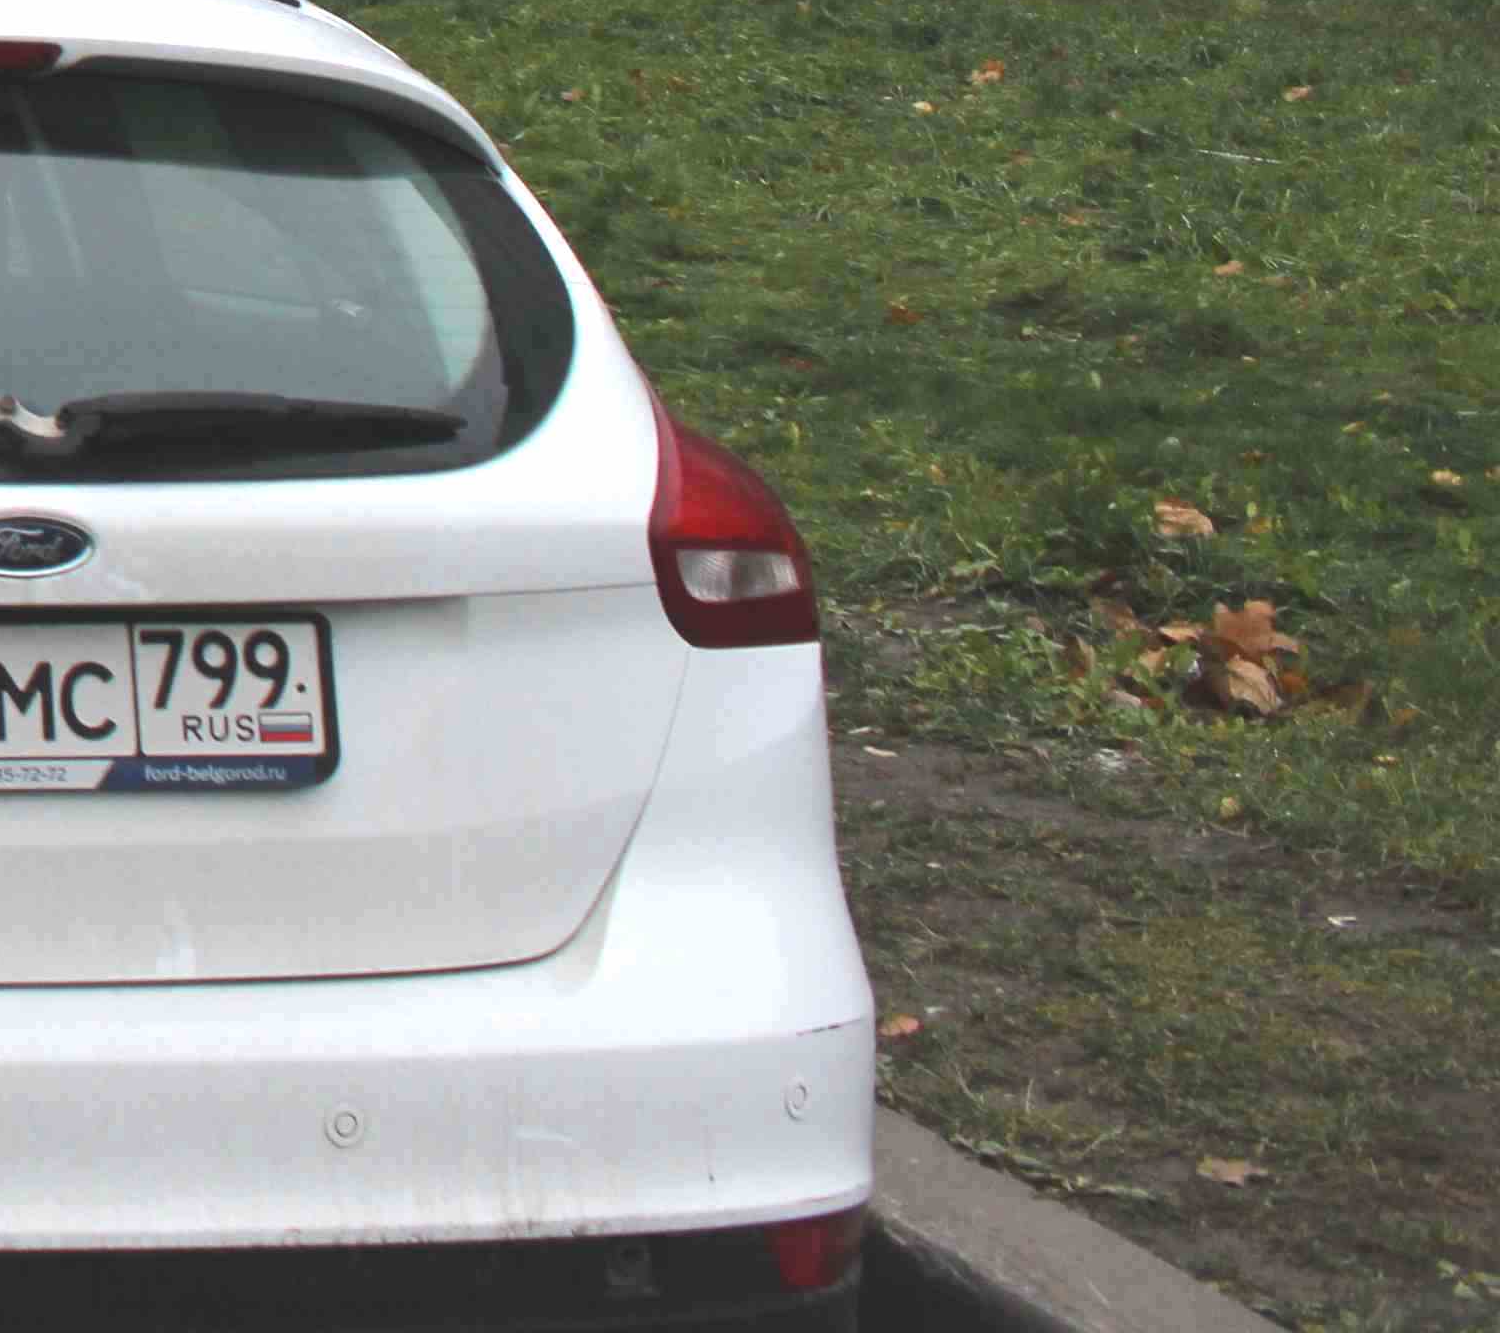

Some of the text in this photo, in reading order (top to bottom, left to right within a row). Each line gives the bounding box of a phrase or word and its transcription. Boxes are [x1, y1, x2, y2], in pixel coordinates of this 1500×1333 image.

[139, 628, 292, 711] 799
[181, 713, 256, 742] RUS
[144, 764, 287, 786] ford-belgorod.ru
